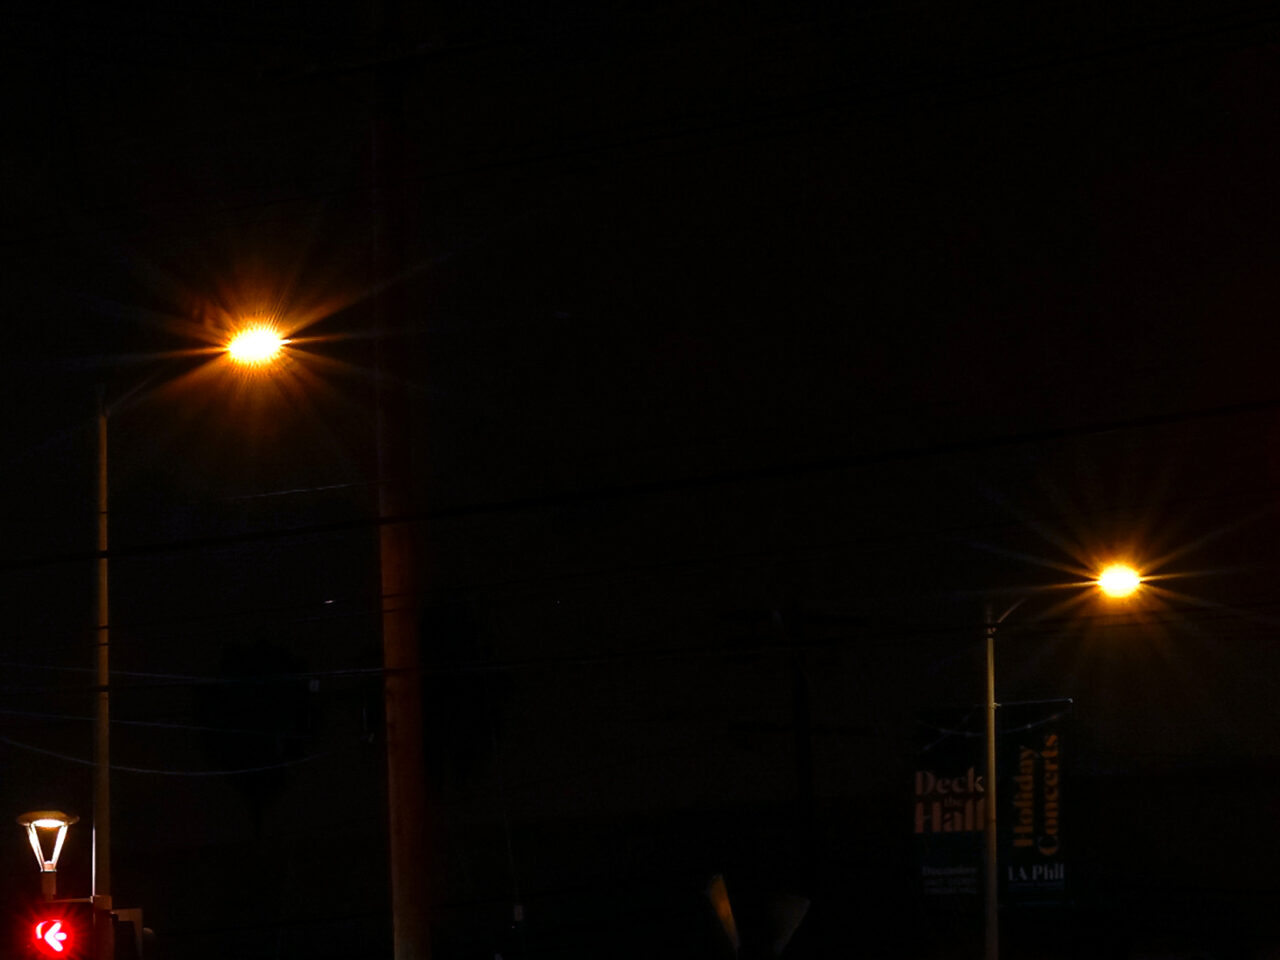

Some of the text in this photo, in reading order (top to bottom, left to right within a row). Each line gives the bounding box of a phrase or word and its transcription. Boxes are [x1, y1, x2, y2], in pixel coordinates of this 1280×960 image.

[913, 797, 986, 834] Hall
[914, 767, 985, 796] Deck
[1012, 744, 1040, 847] Holiday
[1036, 732, 1061, 856] Concerts
